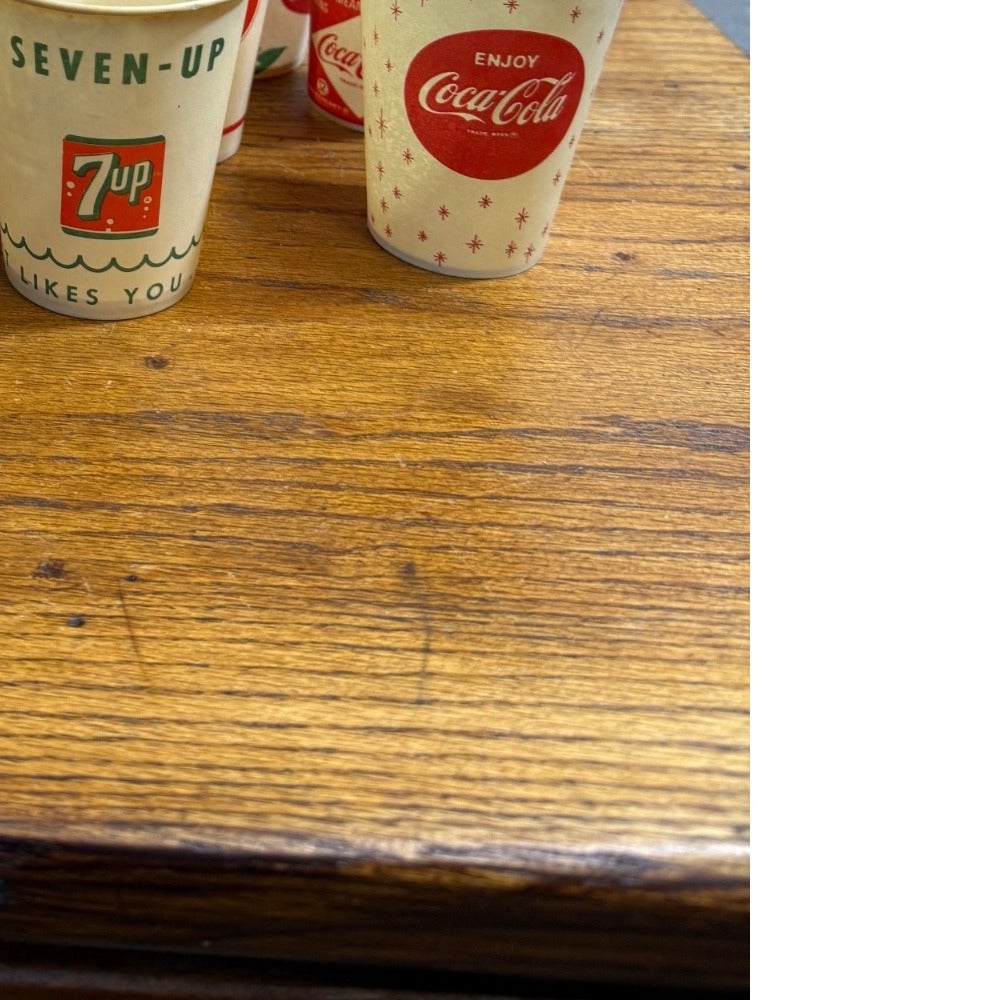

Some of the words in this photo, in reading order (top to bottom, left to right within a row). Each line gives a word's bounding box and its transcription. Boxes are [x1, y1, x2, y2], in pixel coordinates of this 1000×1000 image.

[10, 35, 225, 86] SEVEN-UP
[475, 51, 540, 69] ENJOY
[418, 71, 577, 126] Coca-Cola
[20, 266, 99, 305] LIKES
[123, 273, 182, 305] YOU
